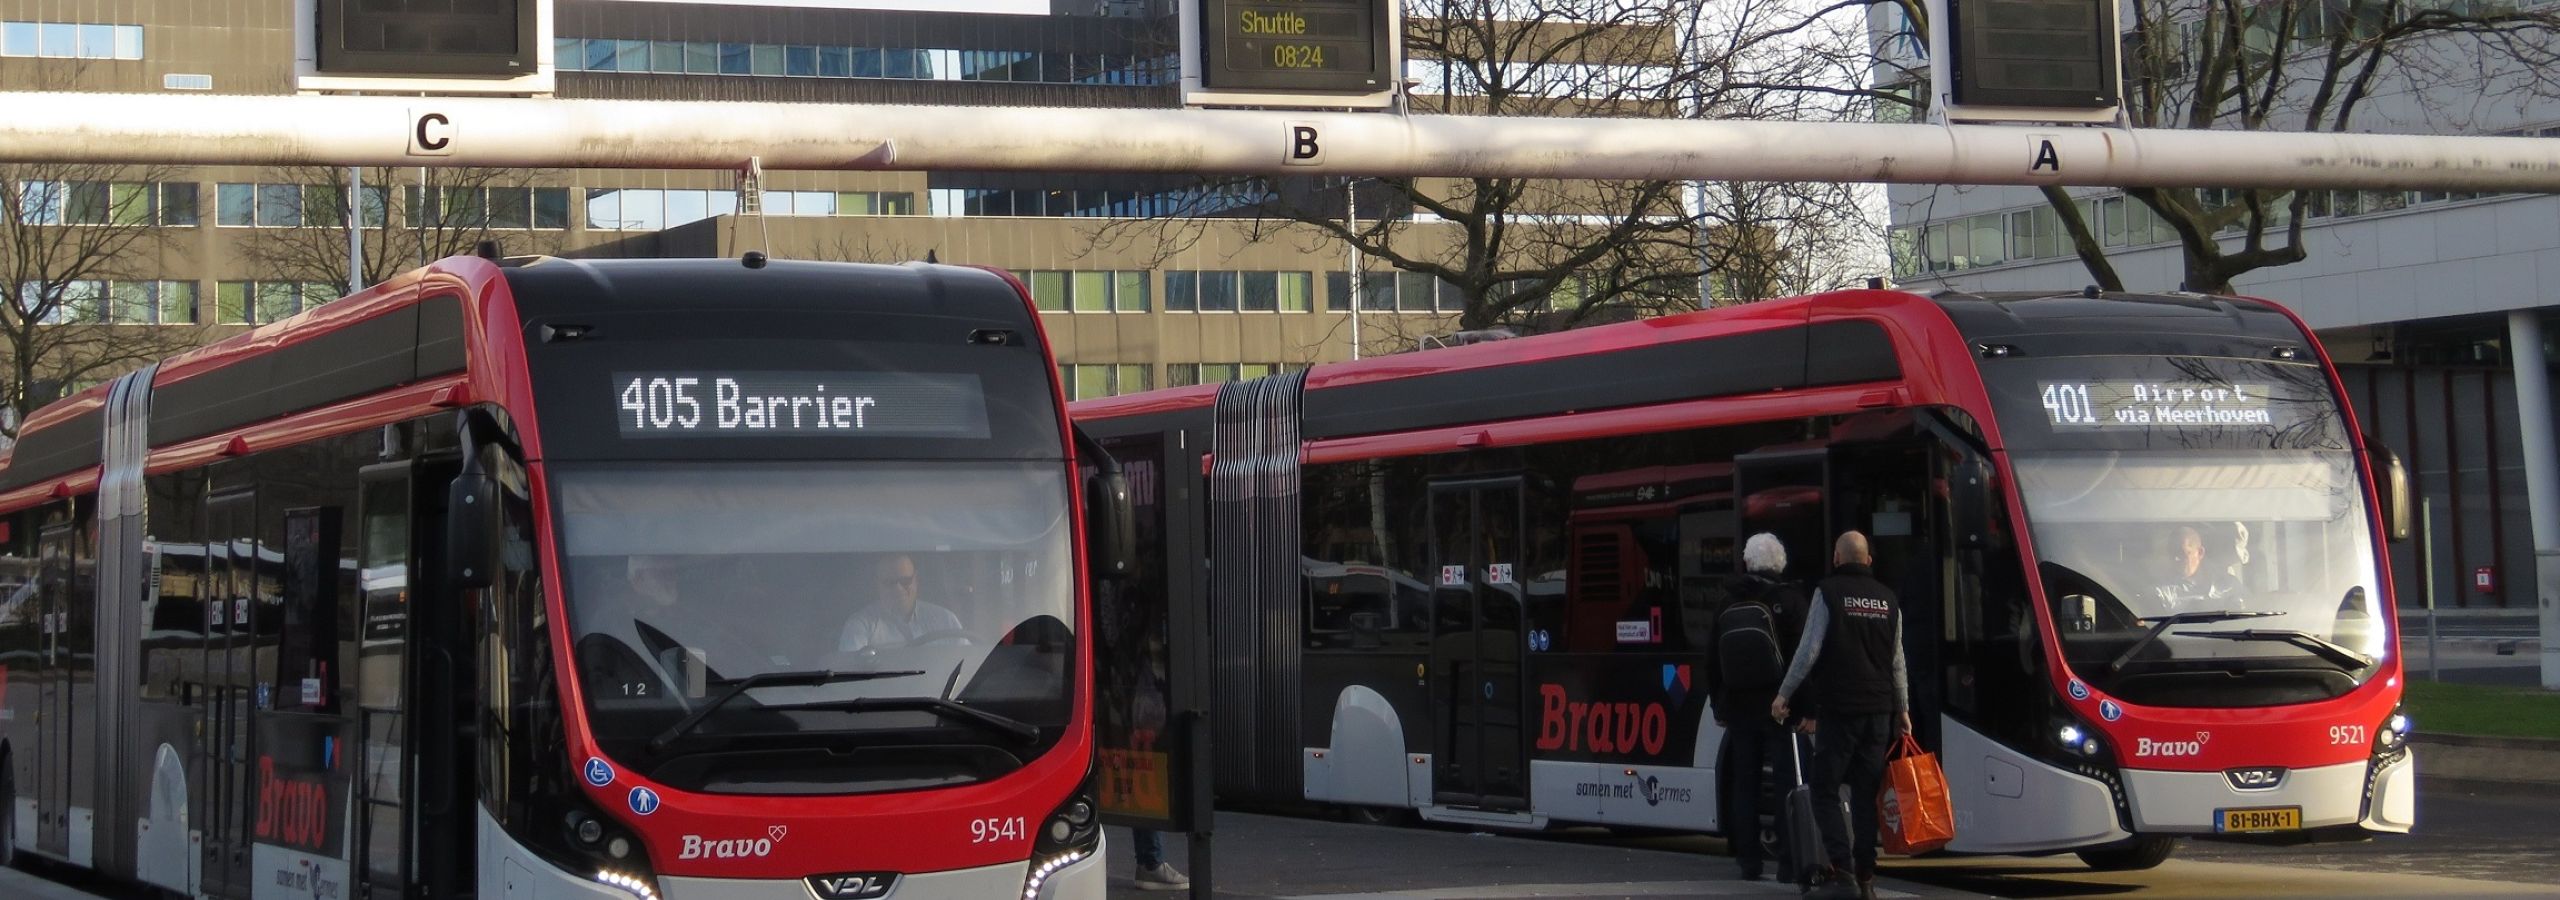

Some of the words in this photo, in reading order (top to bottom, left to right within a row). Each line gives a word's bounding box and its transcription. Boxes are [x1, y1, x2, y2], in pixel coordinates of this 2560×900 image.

[1241, 10, 1306, 35] Shuttle
[1274, 45, 1323, 68] 08:24
[416, 112, 450, 151] C
[1293, 126, 1319, 159] B
[2032, 139, 2059, 171] A
[621, 377, 701, 429] 405
[716, 377, 876, 429] Barrier
[2042, 384, 2096, 423] 401
[2132, 384, 2249, 403] Airport
[2114, 405, 2151, 424] via
[2155, 405, 2271, 424] Meerhoven
[1843, 596, 1889, 611] ENGELS
[1536, 683, 1667, 756] Bravo
[2135, 737, 2200, 757] Bravo
[2329, 725, 2365, 745] 9521
[2233, 770, 2277, 785] VDL
[256, 754, 327, 849] Bravo
[1576, 782, 1611, 798] samen
[1613, 782, 1634, 799] met
[970, 816, 1026, 843] 9541
[2230, 811, 2291, 829] 81-BHX-1
[678, 834, 772, 860] Bravo
[819, 877, 884, 893] VDL
